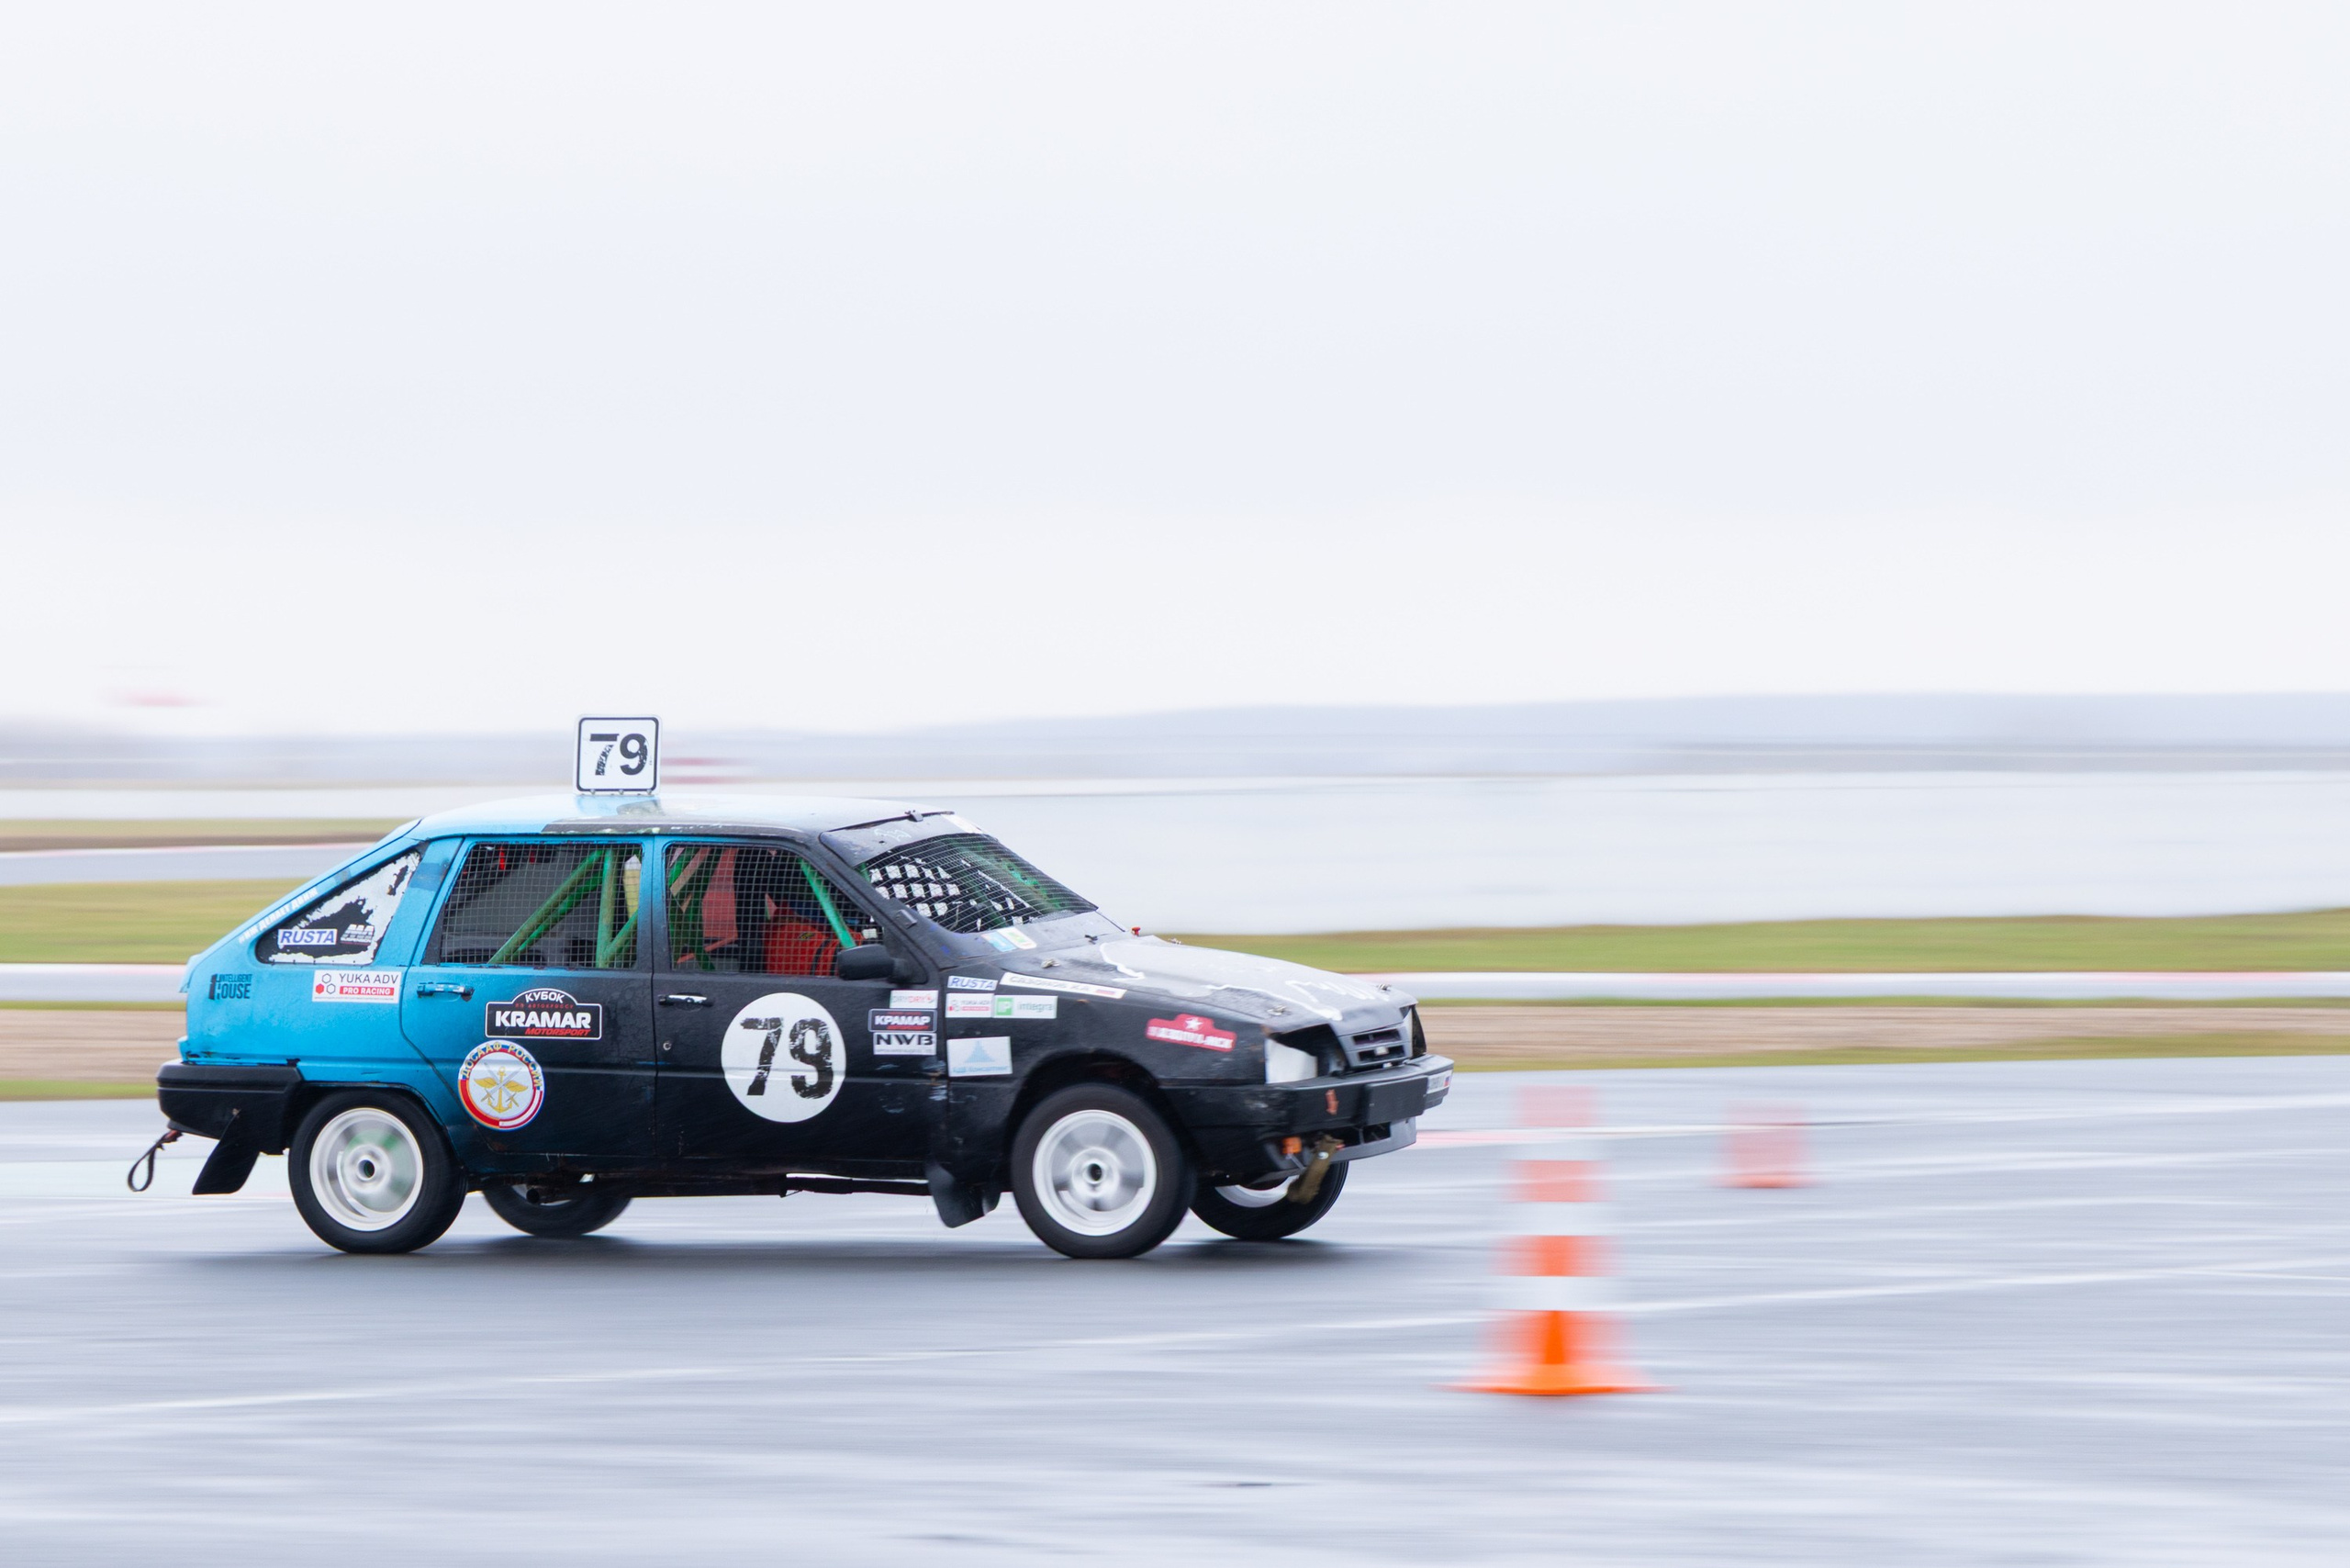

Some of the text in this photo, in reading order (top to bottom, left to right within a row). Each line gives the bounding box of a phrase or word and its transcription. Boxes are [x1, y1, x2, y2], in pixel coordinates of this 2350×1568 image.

[589, 733, 649, 777] 79
[279, 929, 336, 945] RUSTA
[339, 973, 399, 985] YUKA ADV
[949, 976, 995, 989] RUSTA
[360, 987, 391, 995] RACING
[524, 991, 565, 1003] КУБОК
[495, 1010, 592, 1029] KRAMAR
[874, 1014, 931, 1025] КРАМАР
[524, 1027, 592, 1036] MOTORSPORT
[877, 1034, 934, 1046] NWB
[739, 1015, 834, 1101] 79
[460, 1041, 543, 1088] ДОСААФ РОССИИ
